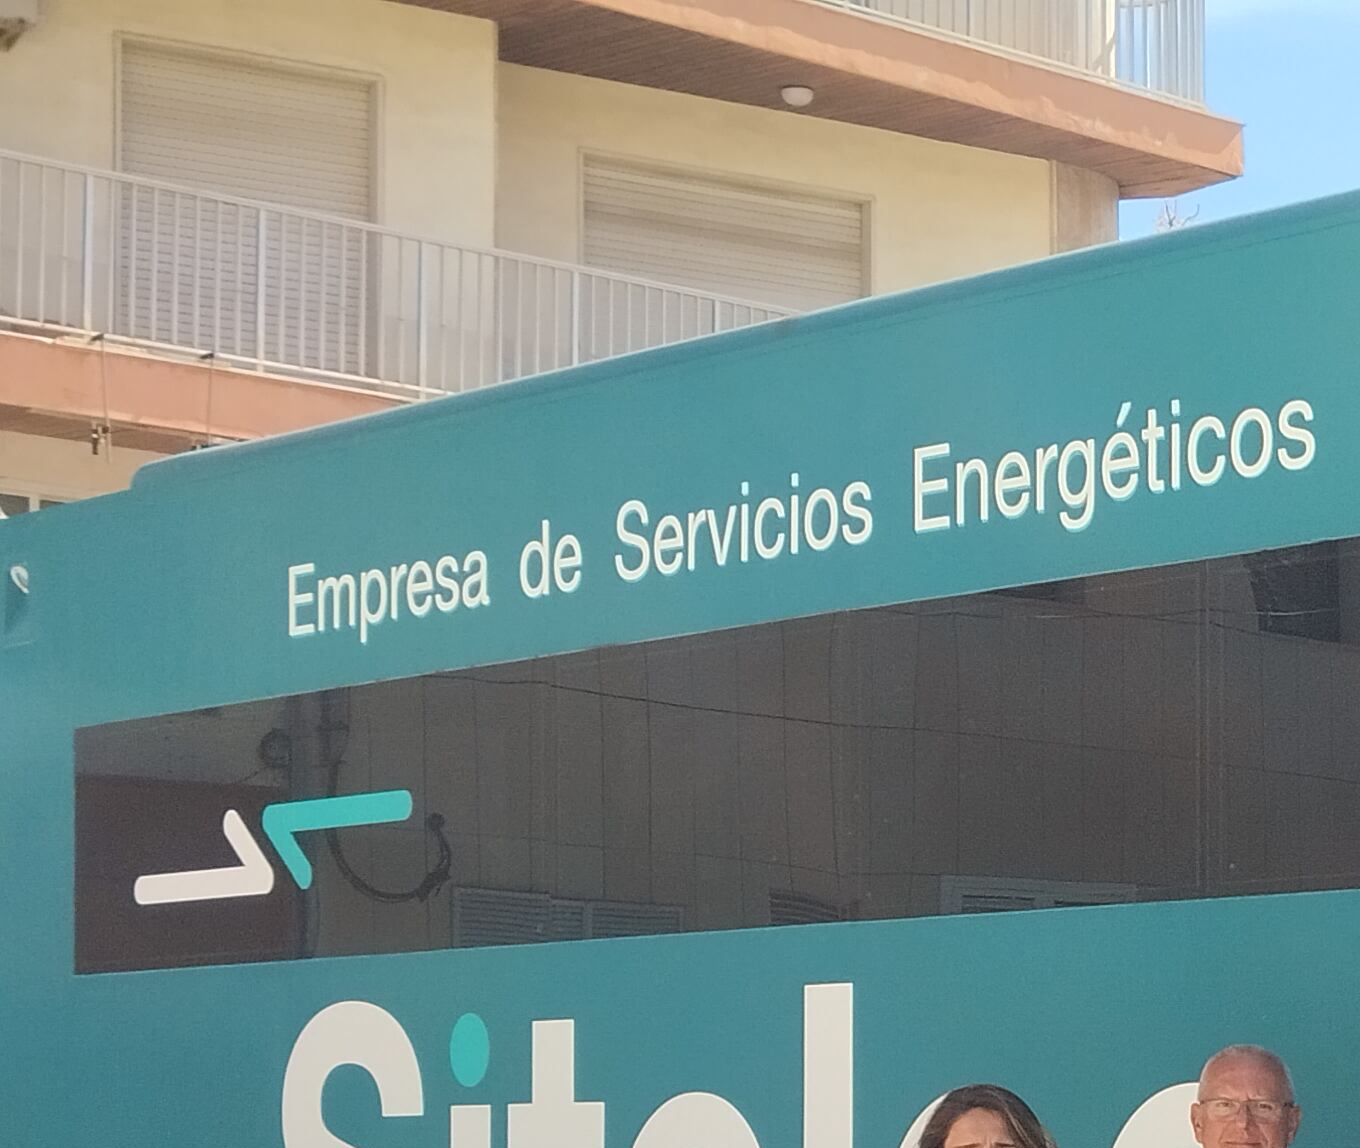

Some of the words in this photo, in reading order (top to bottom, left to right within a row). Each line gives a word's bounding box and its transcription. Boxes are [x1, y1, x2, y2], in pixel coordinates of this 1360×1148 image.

[289, 562, 490, 644] Empresa
[519, 518, 583, 599] de
[614, 472, 873, 582] Servicios
[913, 399, 1317, 534] Energéticos
